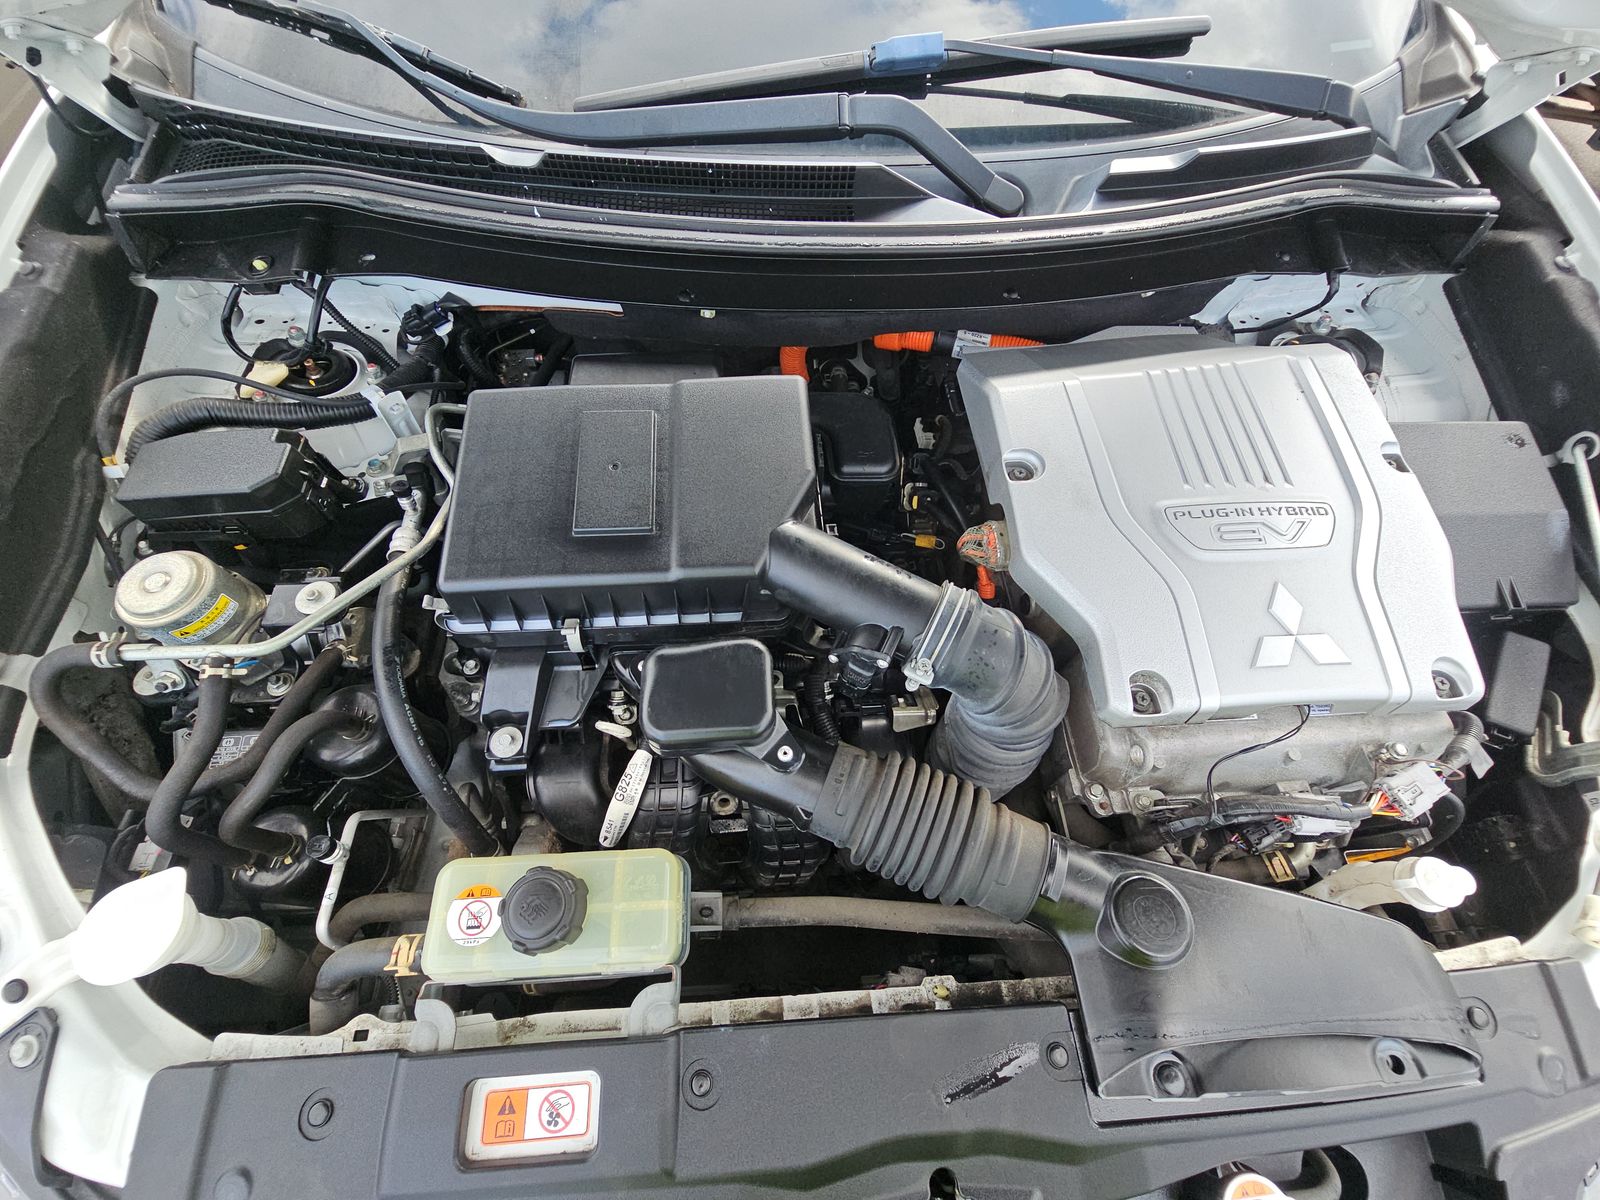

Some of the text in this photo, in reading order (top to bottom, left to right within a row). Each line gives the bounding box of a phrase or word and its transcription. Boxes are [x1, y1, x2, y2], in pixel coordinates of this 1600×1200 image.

[1173, 506, 1329, 520] PLUG-IN HYBRID
[1210, 518, 1312, 545] EV
[615, 772, 633, 802] G825
